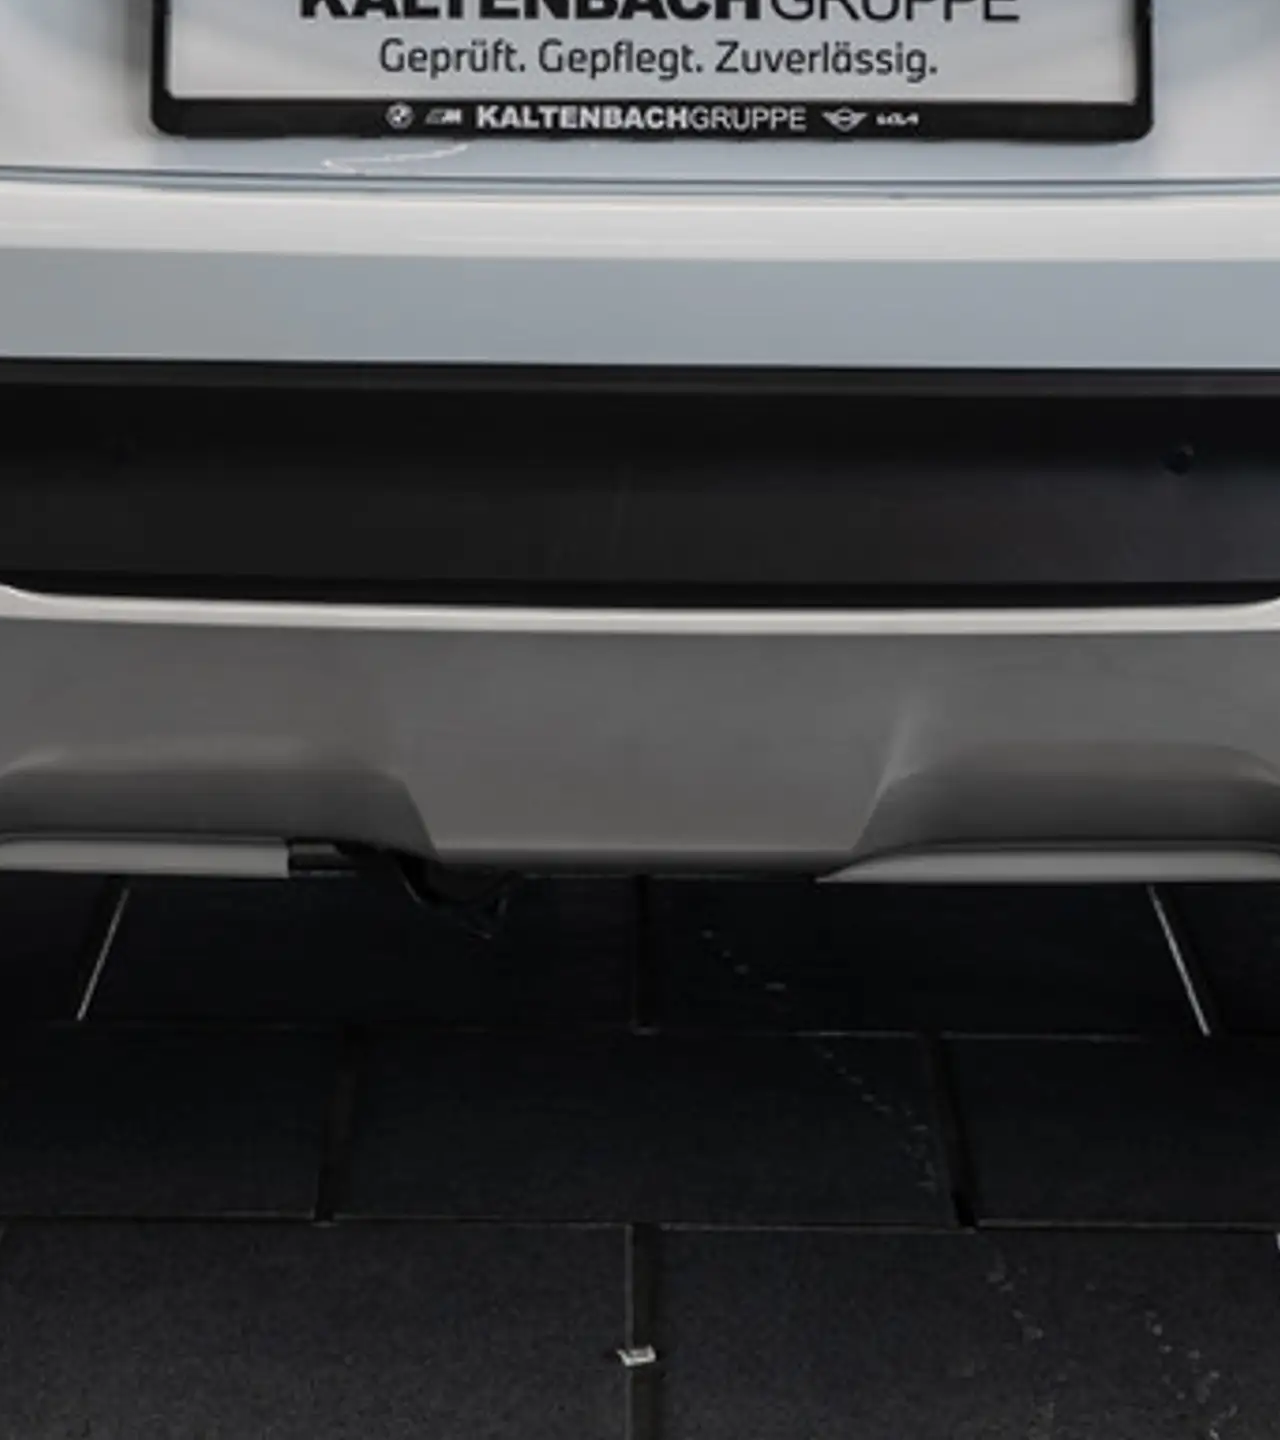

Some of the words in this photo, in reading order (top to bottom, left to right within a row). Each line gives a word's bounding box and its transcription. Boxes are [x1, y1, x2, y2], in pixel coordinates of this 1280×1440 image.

[378, 37, 526, 80] Geprüft.
[538, 37, 704, 81] Gepflegt.
[715, 40, 938, 83] Zuverlässig.
[477, 104, 806, 131] KALTENBACHGRUPPE
